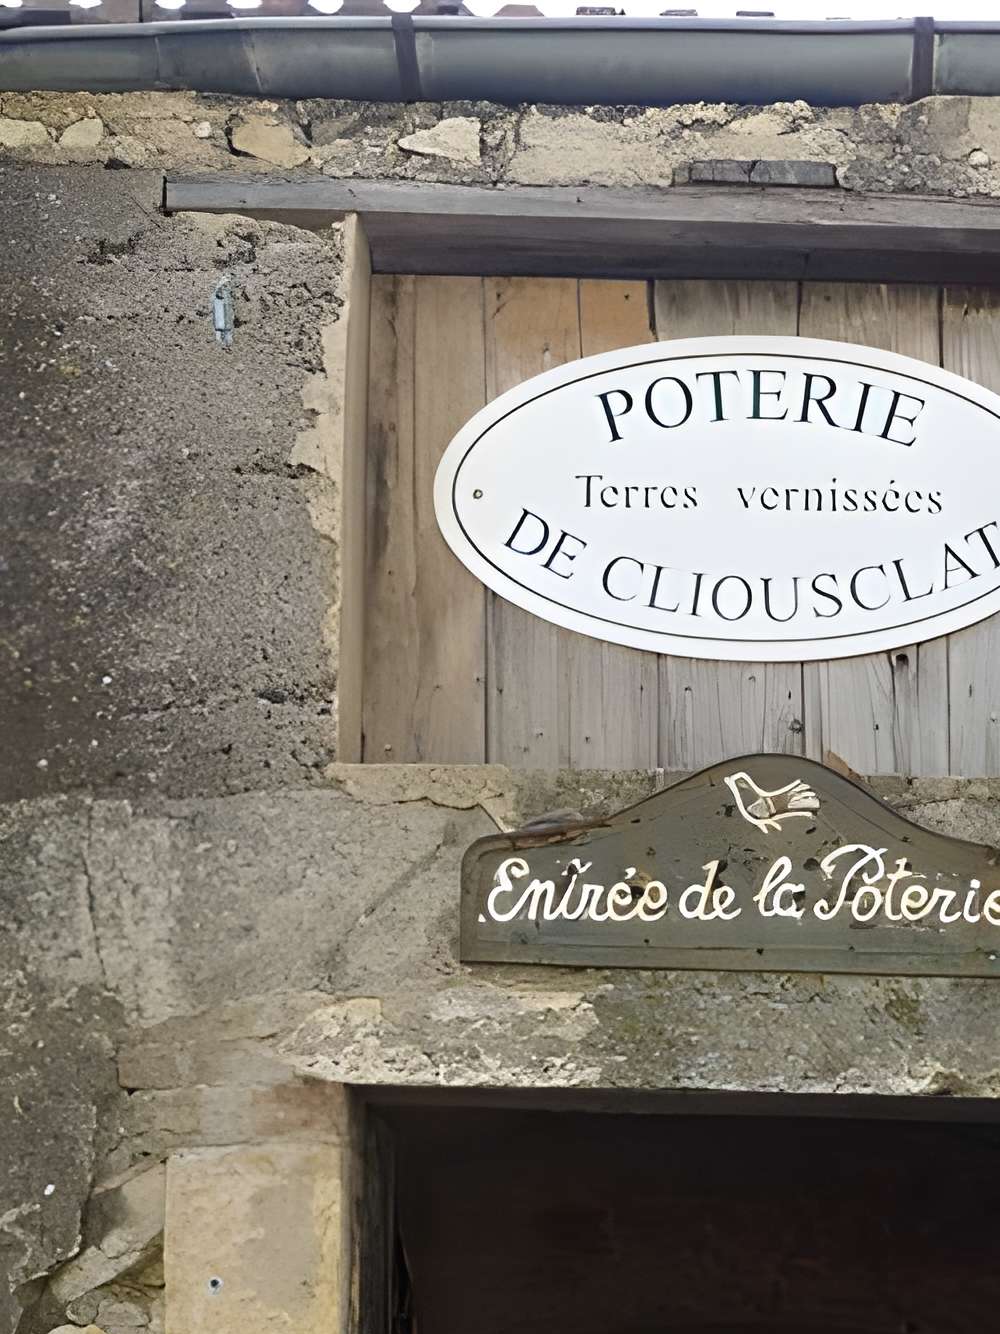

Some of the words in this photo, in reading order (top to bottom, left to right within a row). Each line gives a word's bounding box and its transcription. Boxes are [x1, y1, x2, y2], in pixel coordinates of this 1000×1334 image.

[594, 368, 926, 447] POTERIE
[575, 474, 699, 510] Terres
[736, 477, 943, 515] vernissées
[503, 508, 588, 580] DE
[677, 859, 742, 922] de
[752, 856, 804, 920] la
